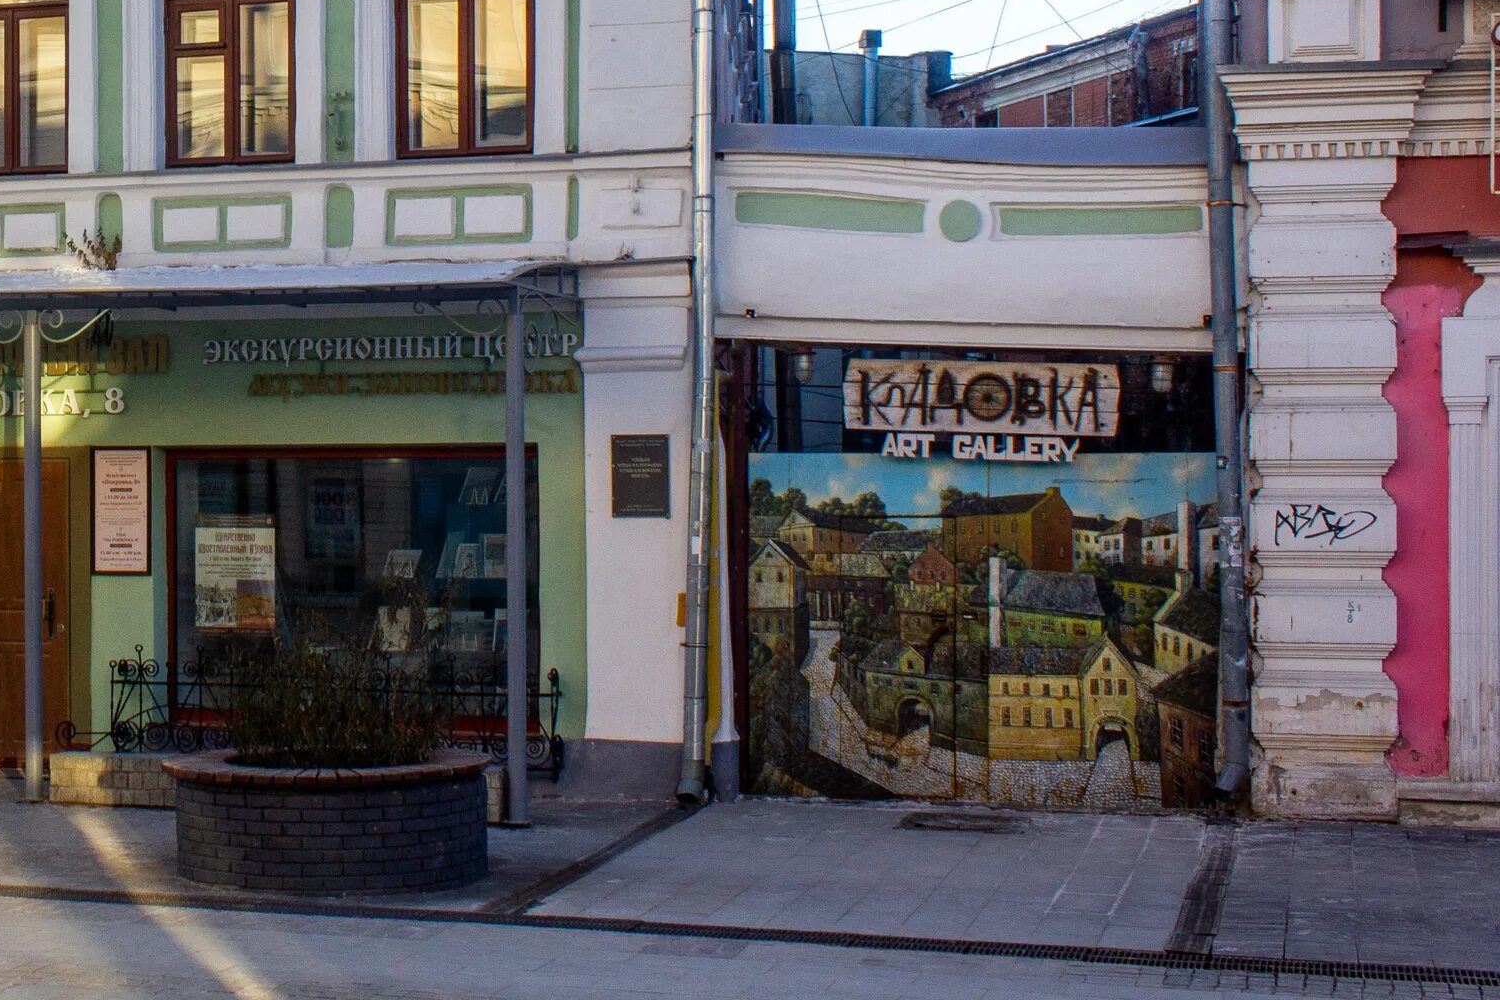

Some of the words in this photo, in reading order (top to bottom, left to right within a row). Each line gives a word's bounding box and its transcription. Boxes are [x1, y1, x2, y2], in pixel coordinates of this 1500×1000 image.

[203, 331, 463, 368] ЭКСКУРСИОННЫЙ
[104, 387, 125, 414] 8
[858, 362, 1099, 433] КЛАДОВКА
[881, 432, 935, 458] ART
[952, 434, 1080, 462] GALLERY
